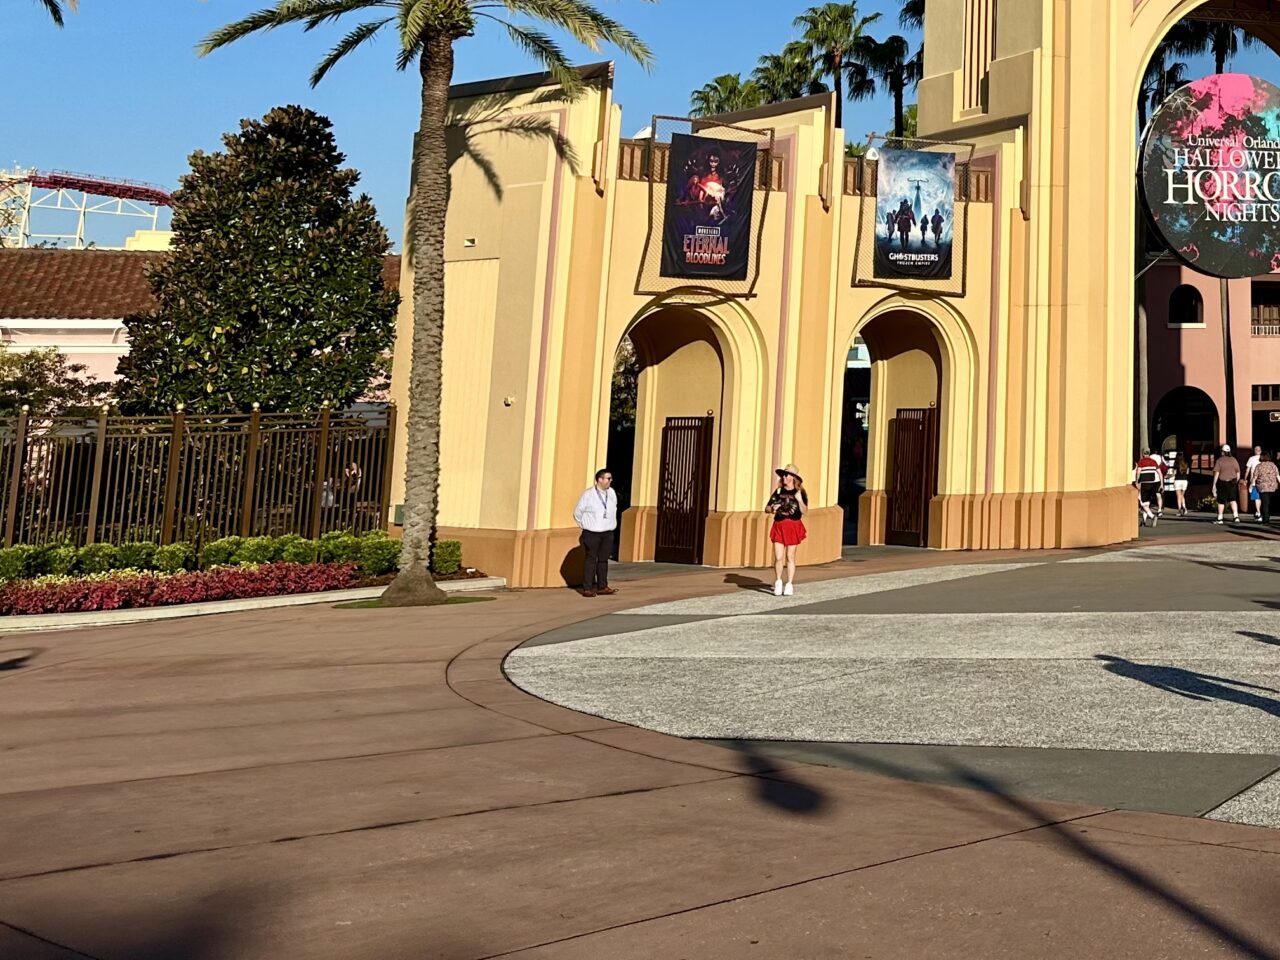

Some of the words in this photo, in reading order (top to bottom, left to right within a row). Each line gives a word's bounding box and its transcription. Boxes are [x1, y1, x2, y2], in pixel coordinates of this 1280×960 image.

[1187, 133, 1239, 148] Universal
[1204, 202, 1280, 223] NIGHTS
[683, 234, 730, 254] ETERNAL
[685, 251, 727, 265] BLOODLINES
[888, 252, 939, 262] GHOSTBUSTERS
